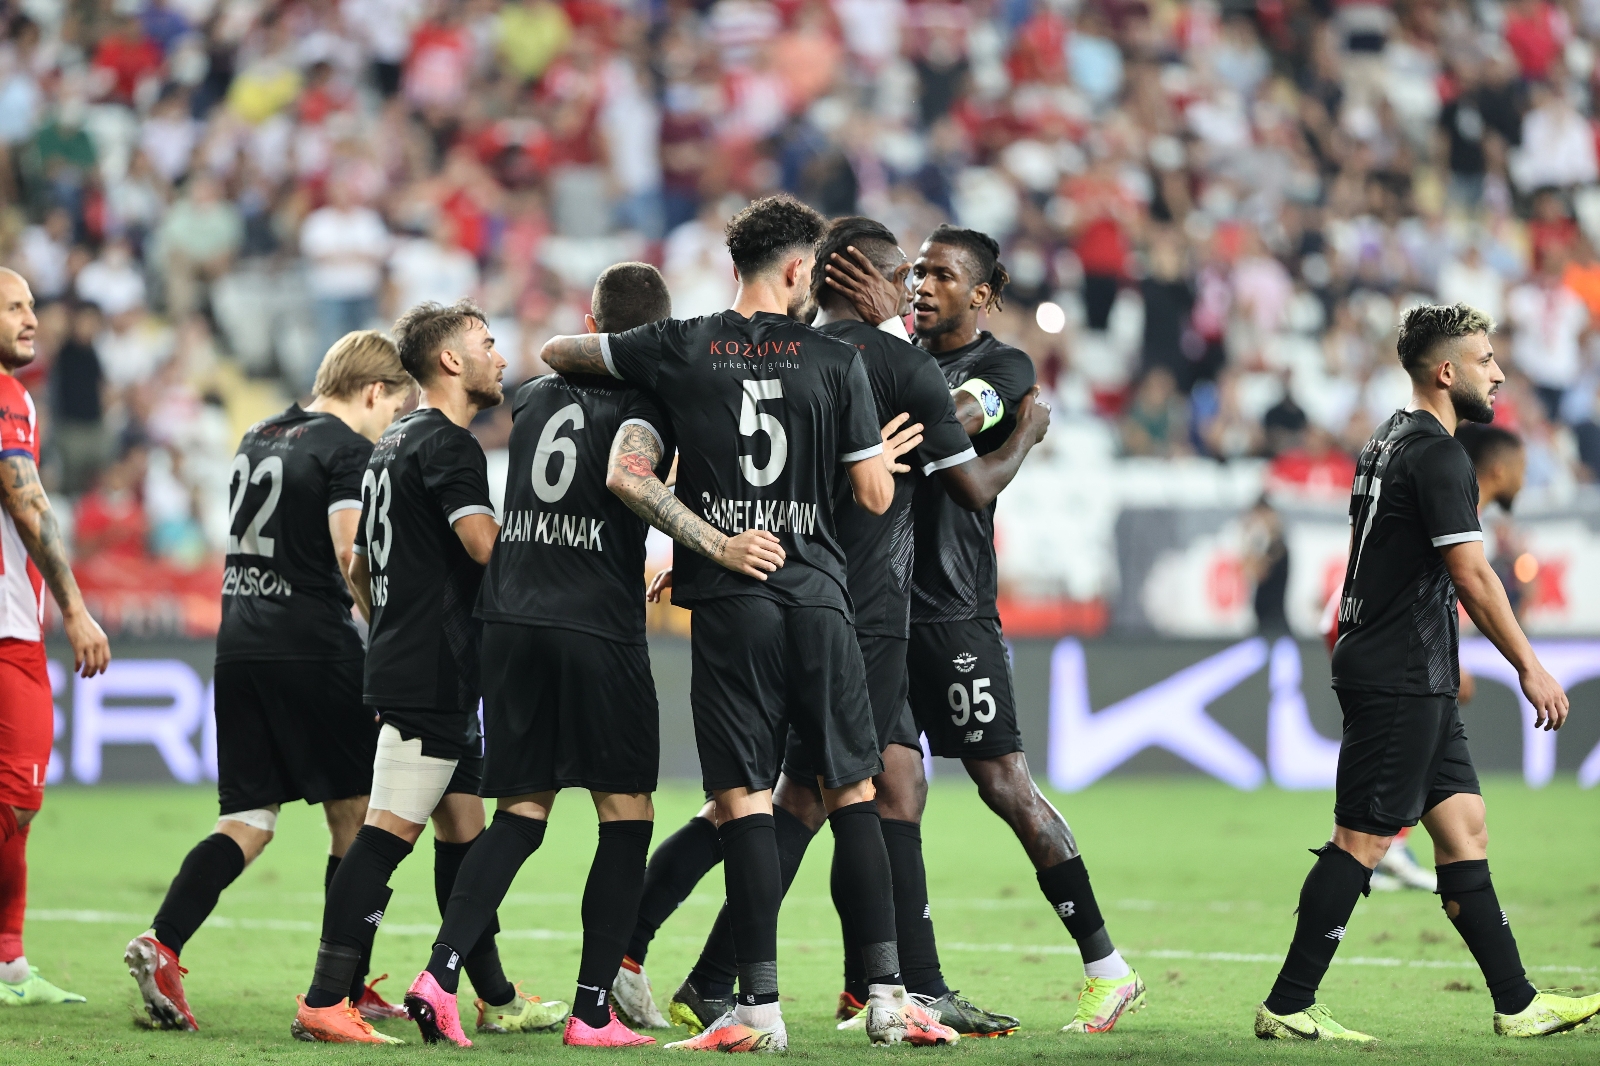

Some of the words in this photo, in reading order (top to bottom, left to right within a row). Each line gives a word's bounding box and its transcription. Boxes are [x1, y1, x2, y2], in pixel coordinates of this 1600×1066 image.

[710, 340, 800, 359] KOZUVA
[767, 360, 800, 373] grubu
[531, 402, 585, 504] 6
[738, 378, 788, 487] 5
[226, 453, 283, 558] 22
[701, 491, 752, 534] SAMET
[534, 511, 606, 552] KANAK
[947, 677, 997, 727] 95
